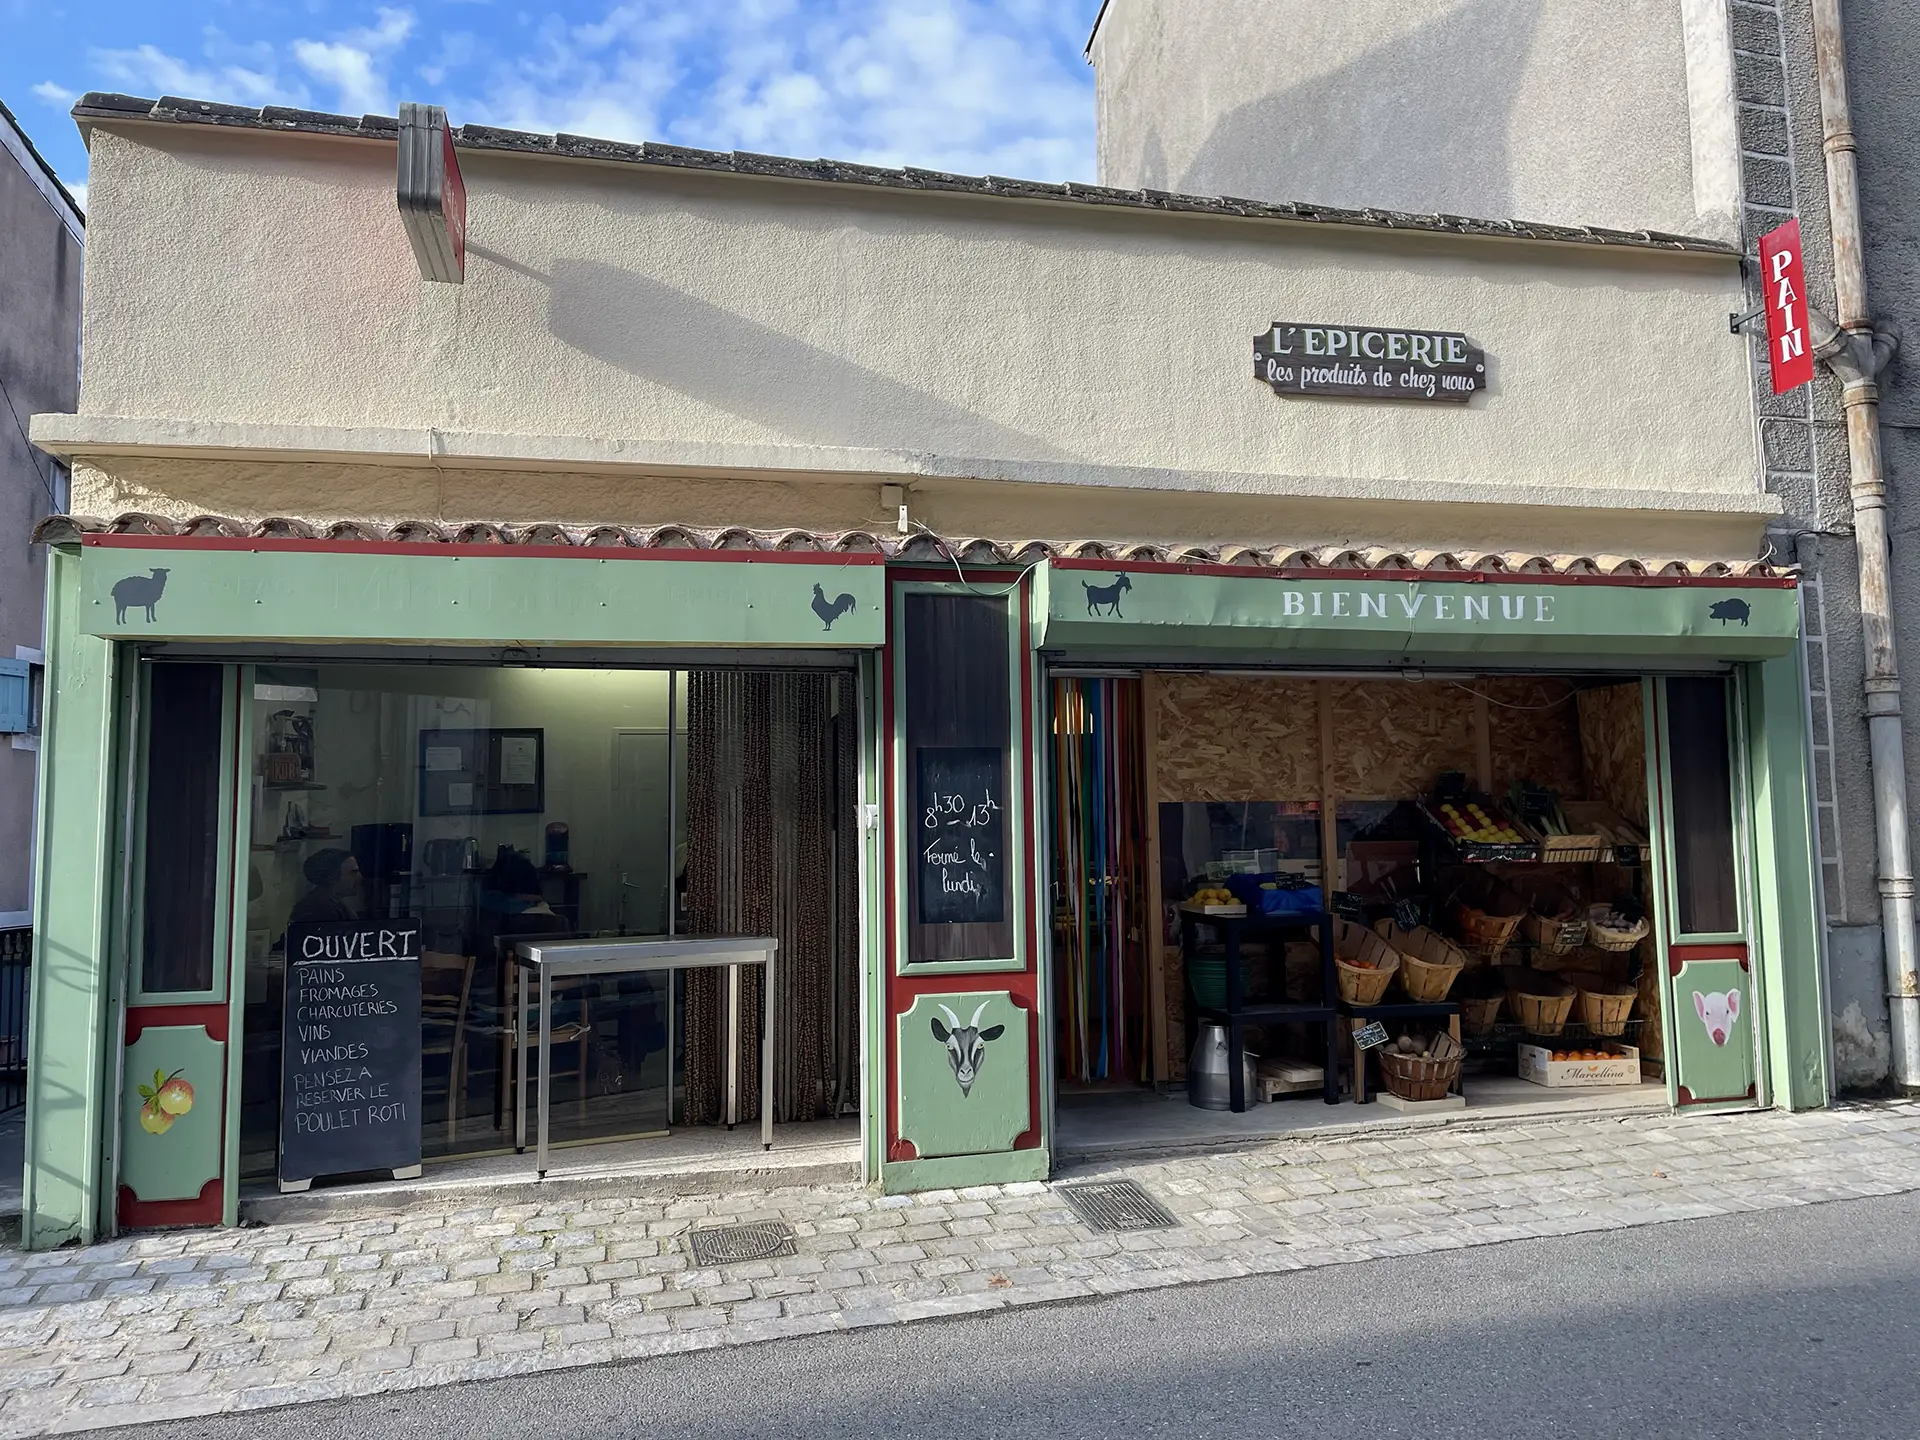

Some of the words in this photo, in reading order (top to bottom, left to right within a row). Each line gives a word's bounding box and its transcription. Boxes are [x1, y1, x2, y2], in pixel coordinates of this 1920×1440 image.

[1771, 250, 1804, 363] PAIN
[1271, 327, 1468, 367] L'EPICERIE
[1267, 358, 1294, 382] les
[1300, 363, 1367, 389] produits
[1373, 365, 1392, 387] de
[1400, 367, 1436, 397] chez
[1442, 378, 1475, 391] nous
[1283, 591, 1555, 622] BIENVENUE
[302, 930, 417, 959] OUVERT
[298, 967, 345, 986] PAINS
[299, 984, 379, 1002] FROMAGES
[297, 1000, 398, 1022] CHARCUTERIES
[299, 1024, 331, 1042] VINS
[301, 1042, 369, 1065] VIANDES
[293, 1068, 357, 1091] PENSEZ
[359, 1066, 372, 1079] A
[1561, 1065, 1624, 1080] Marcellina
[295, 1087, 366, 1109] RESERVER
[370, 1083, 390, 1099] LE
[295, 1108, 361, 1134] POULET
[368, 1102, 407, 1124] ROTI
